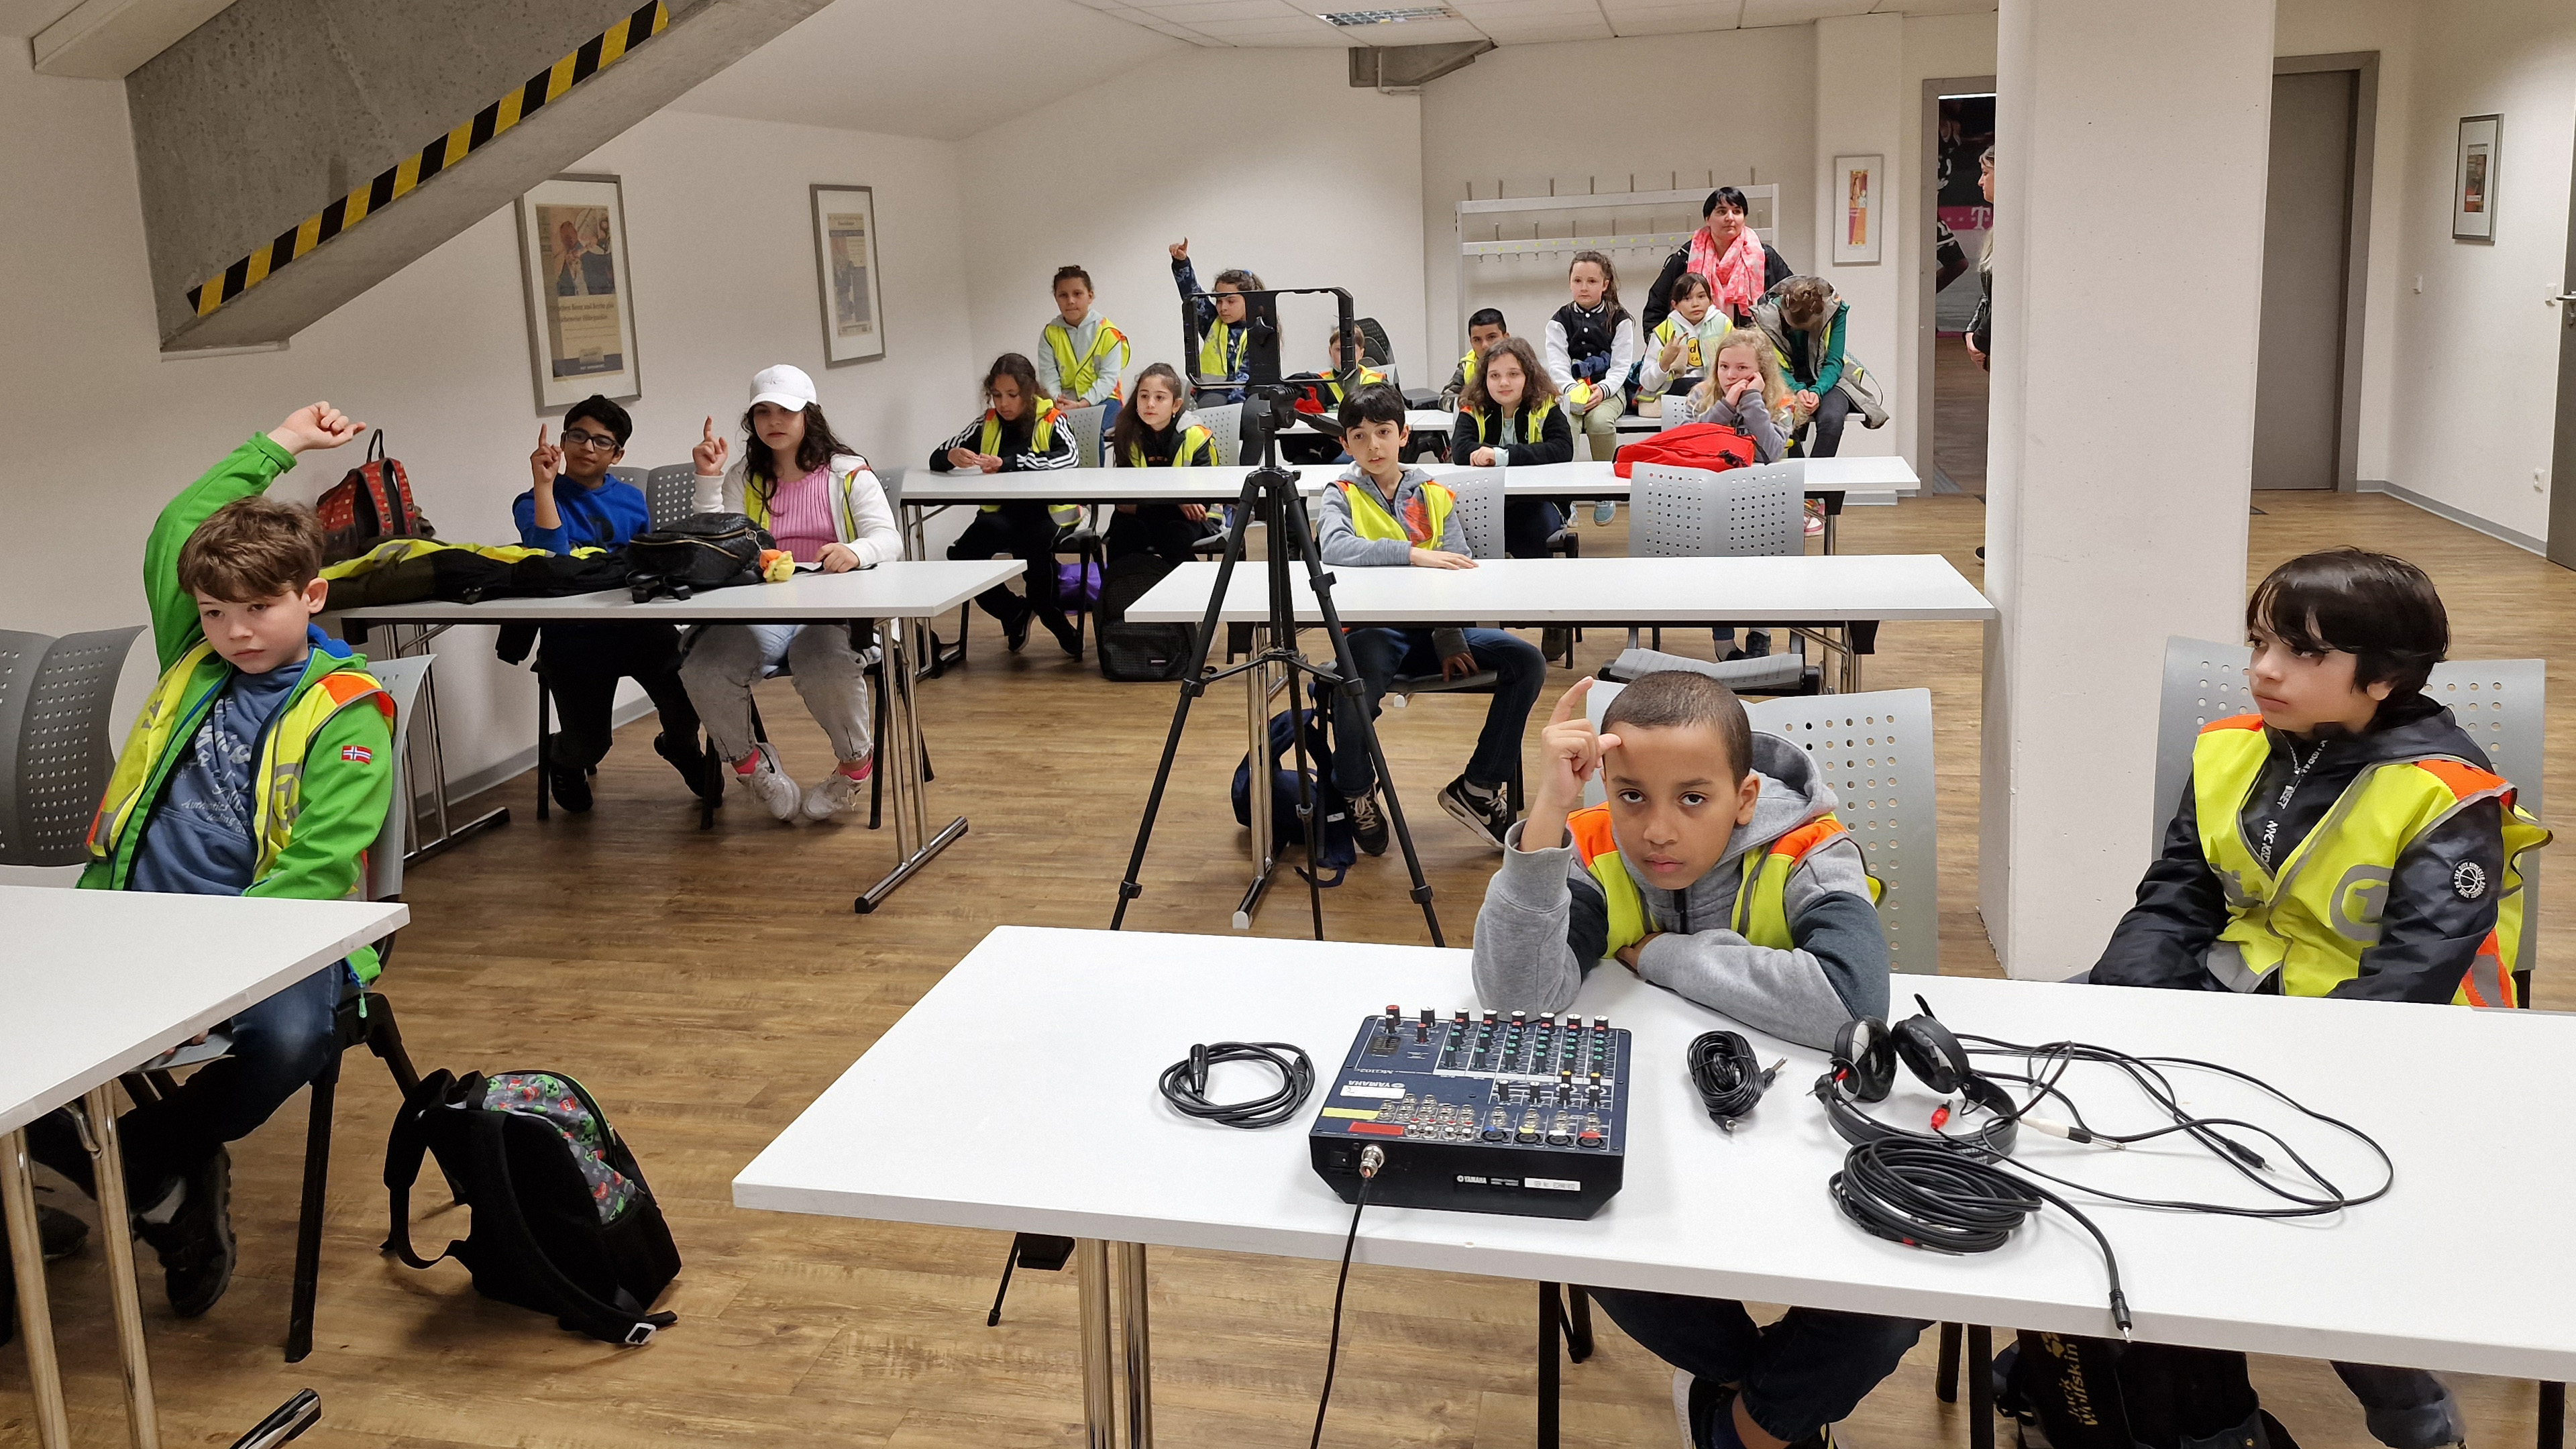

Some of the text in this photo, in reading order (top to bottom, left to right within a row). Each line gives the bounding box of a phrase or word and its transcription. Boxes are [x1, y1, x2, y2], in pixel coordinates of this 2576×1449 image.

[1971, 207, 1991, 229] T
[1348, 1080, 1391, 1088] YAMAHA
[1464, 1176, 1488, 1185] YAMAHA
[2063, 1343, 2098, 1426] Wolfskin
